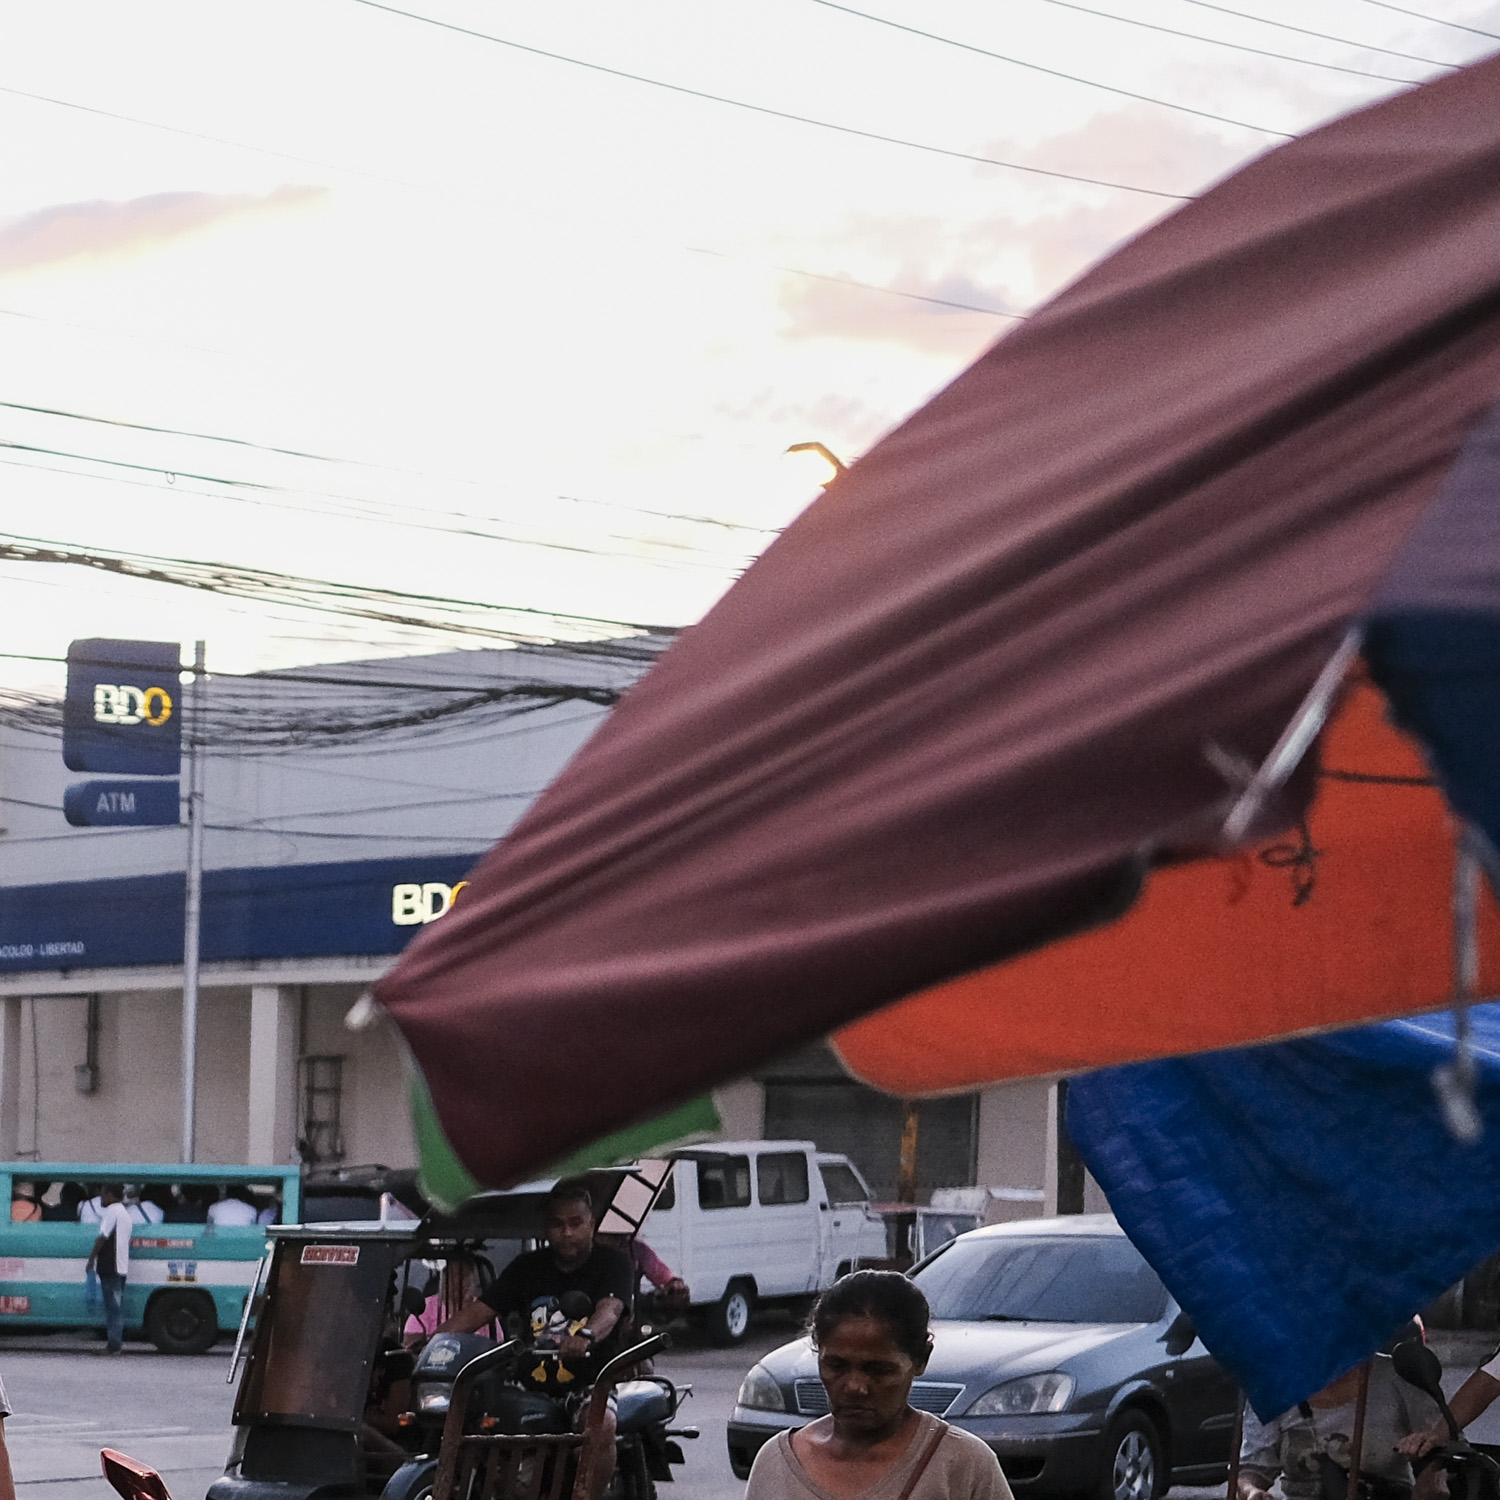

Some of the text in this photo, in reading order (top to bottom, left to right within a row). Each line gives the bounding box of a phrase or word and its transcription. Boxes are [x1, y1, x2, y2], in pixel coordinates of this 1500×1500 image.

[94, 684, 172, 726] BDO
[97, 793, 135, 813] ATM
[392, 881, 471, 926] BD
